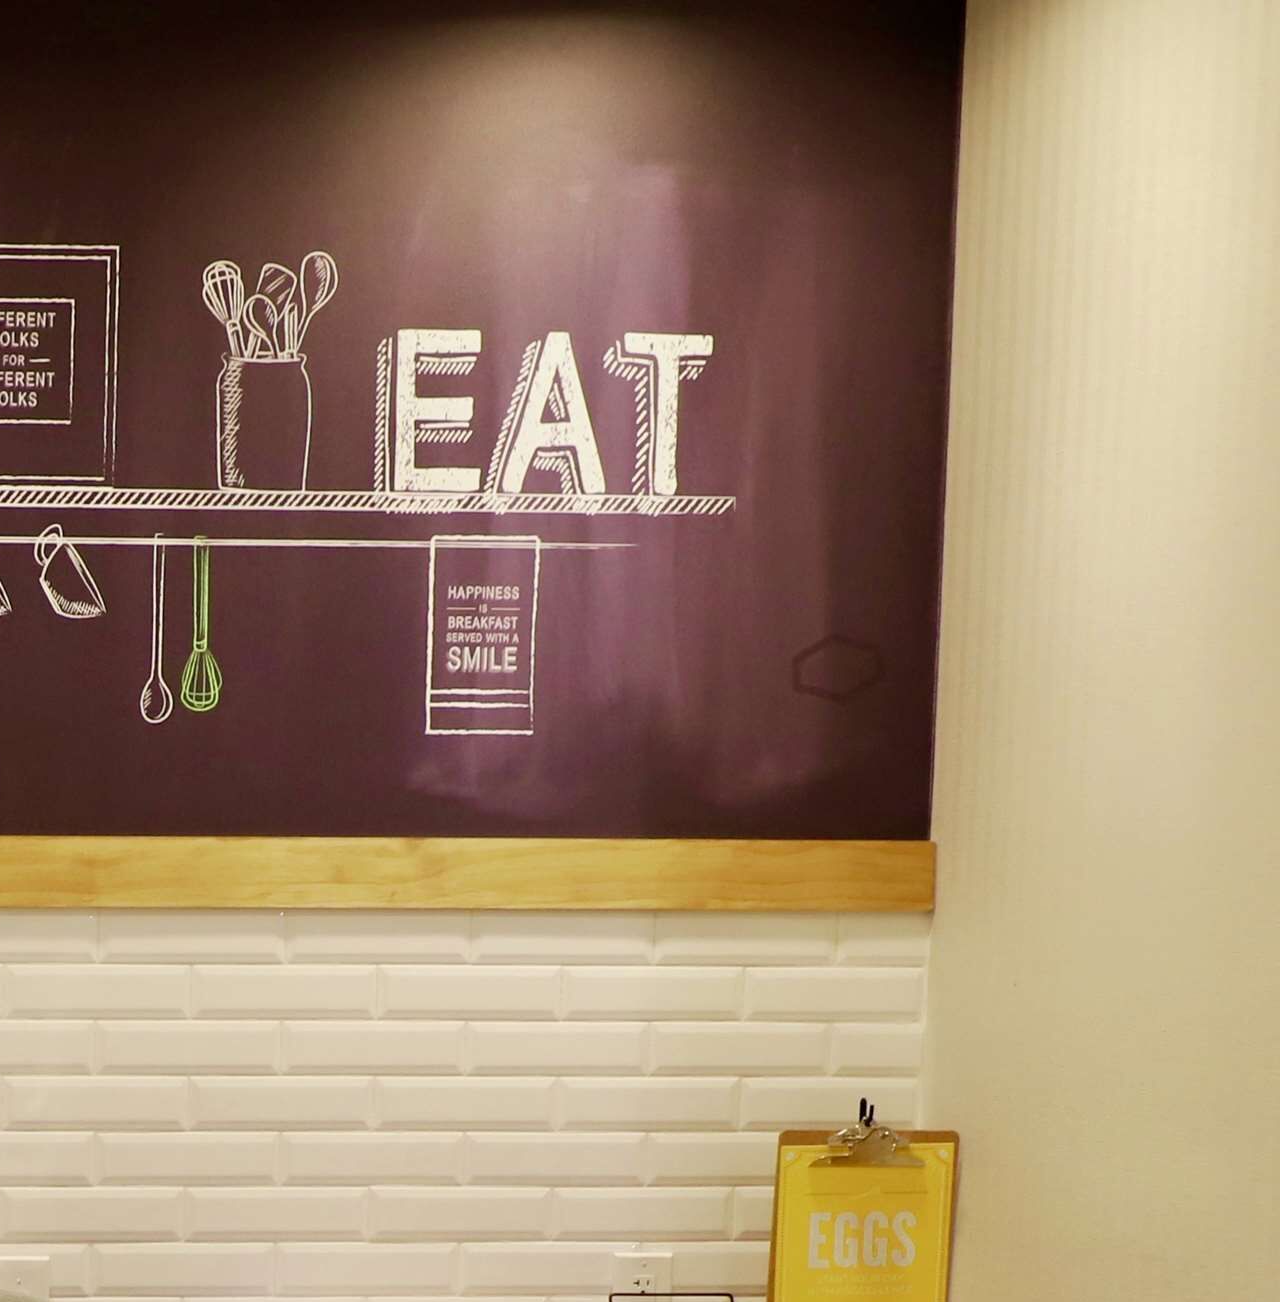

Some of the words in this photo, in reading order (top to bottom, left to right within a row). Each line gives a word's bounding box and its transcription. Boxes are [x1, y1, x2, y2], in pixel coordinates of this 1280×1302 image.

[2, 354, 25, 366] FOR
[375, 328, 714, 496] EAT
[447, 585, 520, 600] HAPPINESS
[478, 604, 488, 613] IS
[447, 616, 518, 630] BREAKFAST
[446, 632, 482, 643] SERVED
[485, 633, 509, 643] WITH
[512, 634, 520, 643] A
[447, 647, 518, 673] SMILE
[807, 1210, 917, 1269] EGGS
